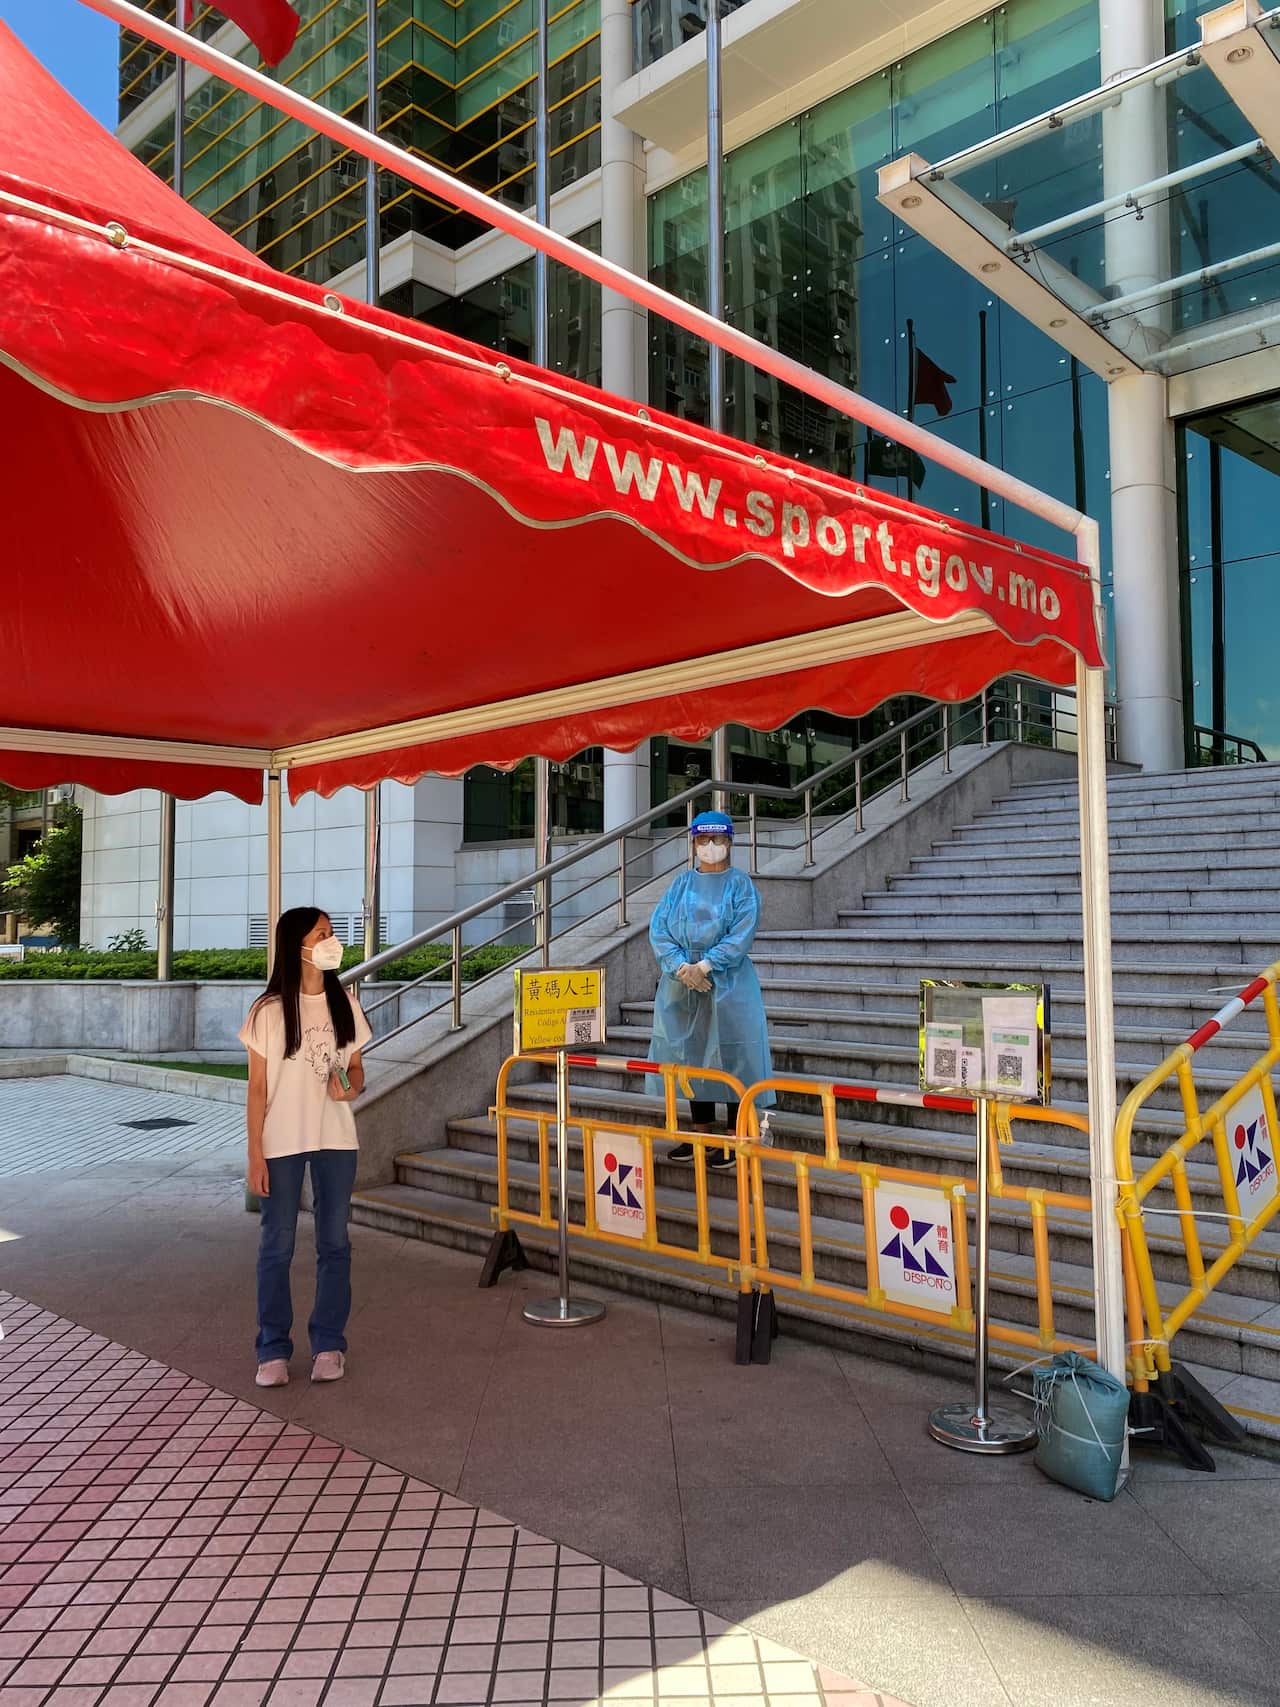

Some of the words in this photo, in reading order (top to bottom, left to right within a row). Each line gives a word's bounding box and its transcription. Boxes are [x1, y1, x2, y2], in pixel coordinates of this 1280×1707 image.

[534, 416, 1061, 621] www.sport.gov.mo
[526, 977, 595, 1000] 黃碼人士
